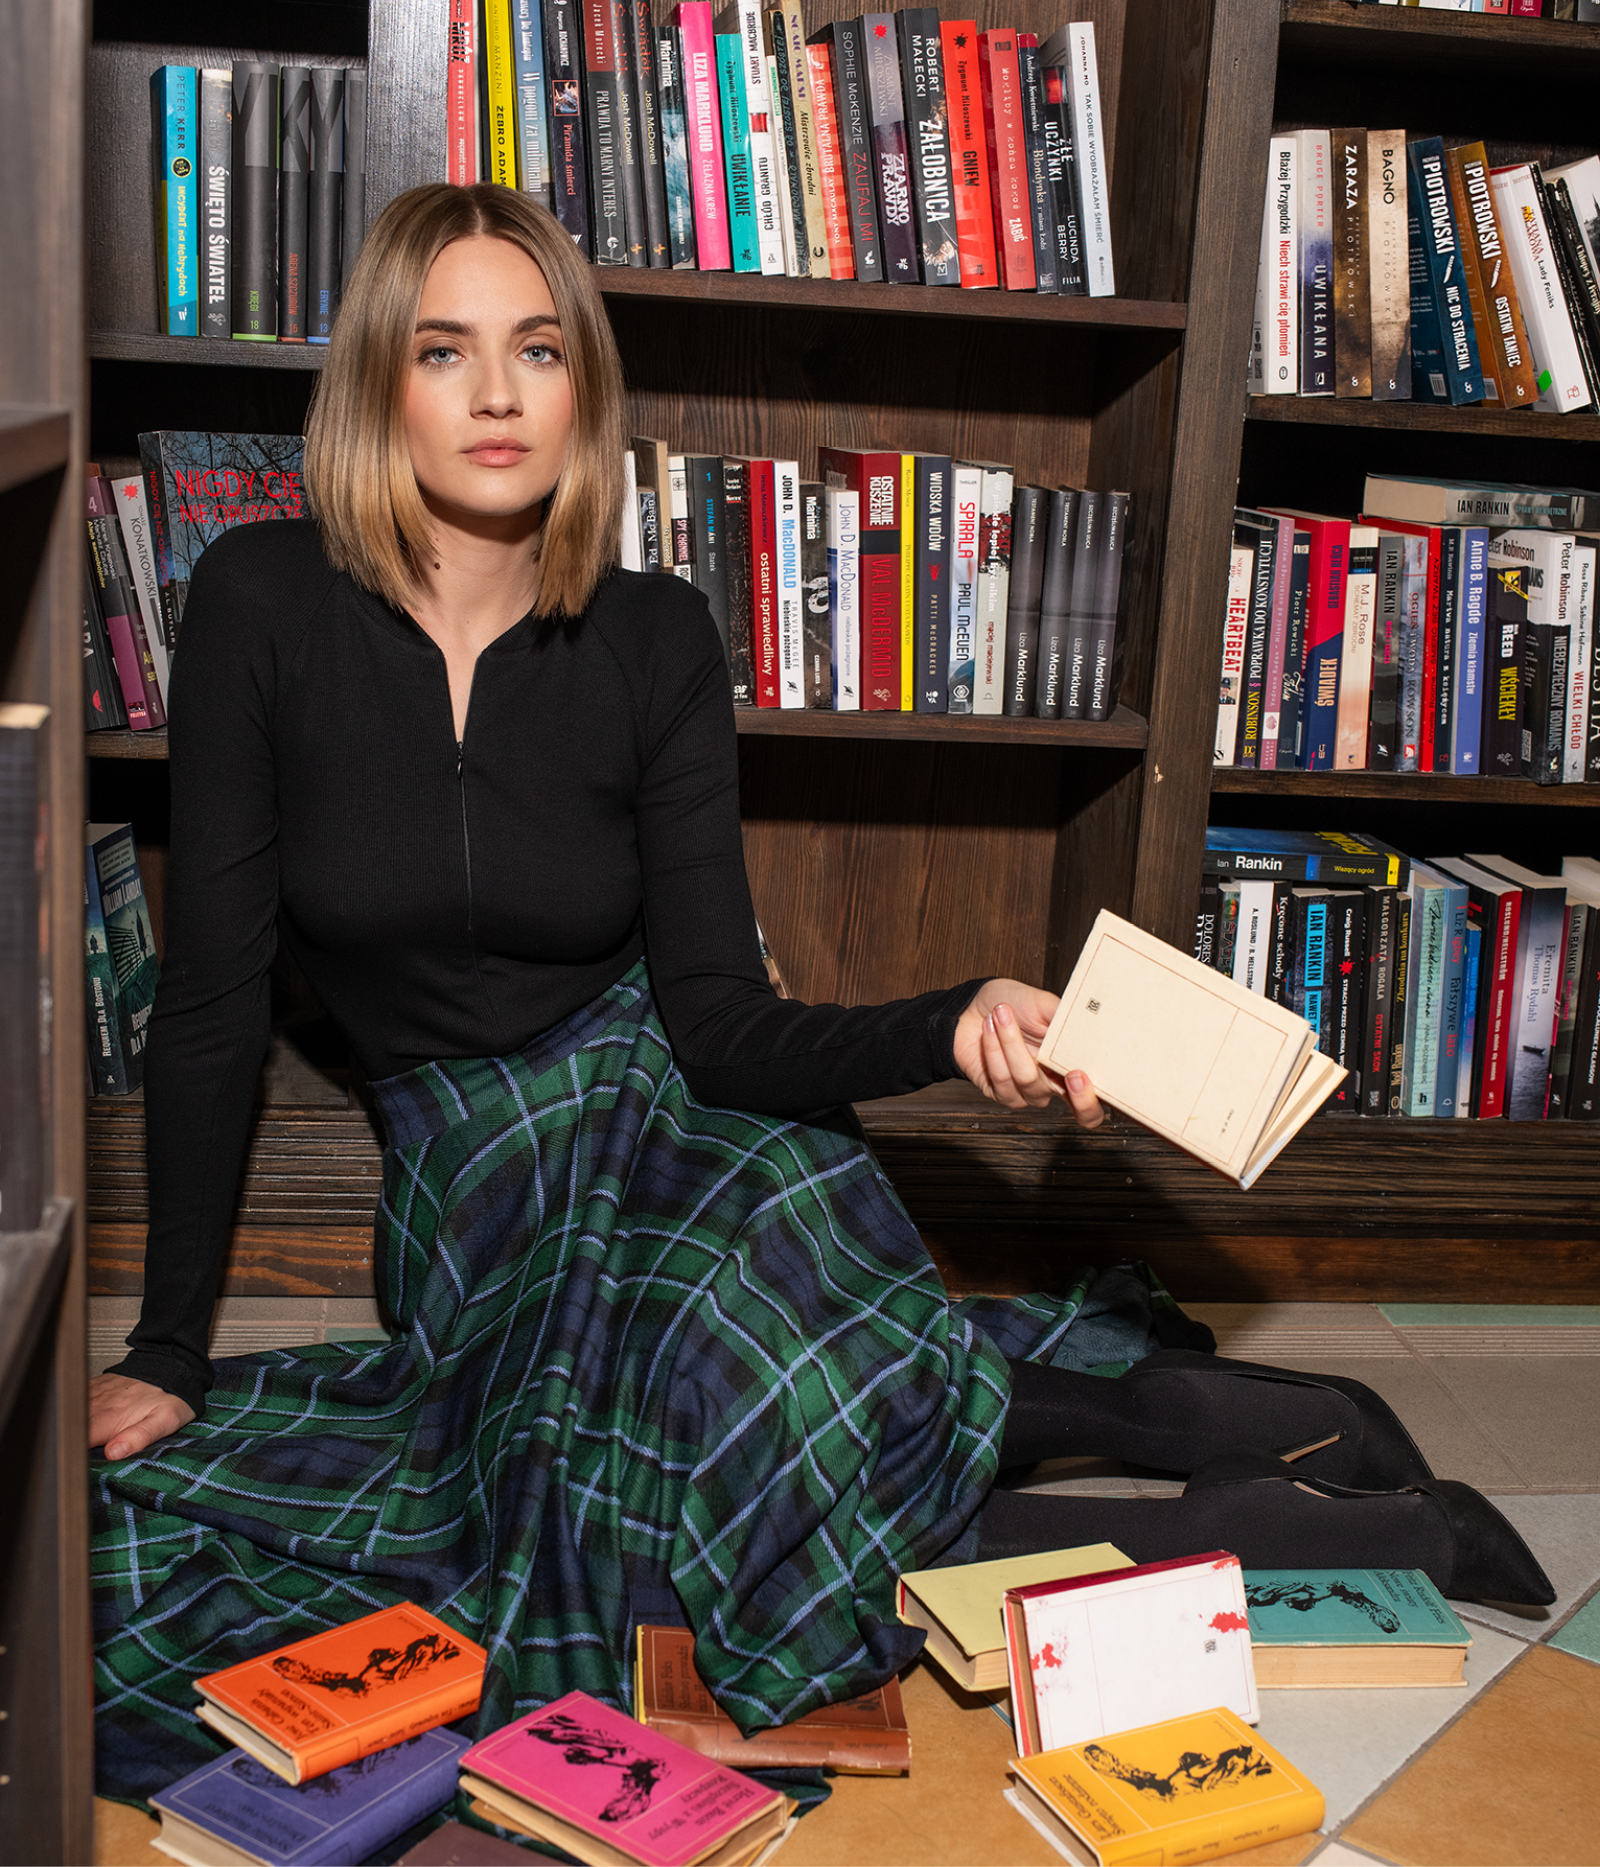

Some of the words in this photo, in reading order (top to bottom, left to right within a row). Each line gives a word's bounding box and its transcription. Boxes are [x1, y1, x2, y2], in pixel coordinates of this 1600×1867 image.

[746, 11, 758, 52] MACBRIDE
[660, 40, 674, 86] Marinina
[692, 52, 708, 79] LIZA
[750, 56, 762, 84] STUART
[842, 32, 856, 78] SOPHIE
[912, 34, 926, 98] MAŁECKI
[925, 38, 939, 92] ROBERT
[1080, 36, 1088, 72] JOHANNA
[177, 76, 186, 111] PETER
[958, 60, 970, 92] Zygmunt
[1084, 74, 1090, 86] MO
[596, 90, 611, 129] PRAWDA
[621, 91, 630, 114] Josh
[645, 90, 654, 114] Josh
[694, 81, 714, 152] MARKLUND
[814, 79, 829, 120] PRAWDA
[848, 83, 864, 145] McKENZIE
[962, 95, 972, 140] Miłoszewski
[176, 118, 186, 150] KERR
[563, 124, 574, 162] Piramida
[598, 131, 611, 144] TO
[623, 117, 634, 165] McDowell
[647, 117, 657, 165] McDowell
[1086, 112, 1094, 138] SOBIE
[600, 146, 614, 178] MARNY
[816, 124, 835, 174] BRUTALNA
[1044, 122, 1062, 181] UCZYNKI
[1060, 138, 1073, 162] ZŁE
[1278, 152, 1292, 180] Błażej
[565, 164, 576, 196] śmierci
[702, 160, 715, 195] ŻELAZNA
[759, 157, 772, 196] GRANITU
[854, 153, 871, 216] ZAUFAJ
[920, 120, 950, 222] ŻAŁOBNICA
[963, 150, 980, 186] GNIEW
[1088, 140, 1100, 210] WYOBRAŻAŁAM
[1346, 145, 1358, 210] ZARAZA
[1383, 149, 1395, 204] BAGNO
[206, 166, 230, 228] ŚWIĘTO
[603, 180, 616, 218] INTERES
[882, 152, 898, 224] PRAWDY
[896, 153, 910, 224] ZIARNO
[705, 197, 716, 220] KREW
[763, 201, 774, 230] CHŁÓD
[1278, 184, 1292, 234] Przygodzki
[1422, 163, 1456, 255] PIOTROWSKI
[1465, 167, 1502, 259] PIOTROWSKI
[862, 224, 874, 242] MI
[1057, 224, 1068, 260] BERRY
[1066, 215, 1080, 264] LUCINDA
[1094, 212, 1104, 244] ŚMIERĆ
[208, 235, 230, 304] ŚWIATEŁ
[288, 253, 298, 277] ARENA
[1280, 240, 1292, 268] Niech
[1346, 217, 1354, 318] PIOTROWSKI
[248, 290, 259, 312] KRĘGI
[288, 278, 299, 316] SZCZURÓW
[320, 290, 329, 314] ERYNIE
[1280, 270, 1292, 300] strawi
[1445, 286, 1460, 302] NIC
[250, 320, 259, 330] 18
[1278, 302, 1292, 317] cię
[1314, 264, 1327, 358] UWIKŁANA
[1449, 305, 1462, 318] DO
[1495, 296, 1514, 334] OSTATNI
[1277, 319, 1292, 356] płomień
[1451, 320, 1470, 370] STRACENIA
[1503, 336, 1521, 368] TANIEC
[150, 471, 160, 501] NIGDY
[176, 470, 256, 498] NIGDY
[264, 472, 302, 504] CIĘ
[782, 475, 794, 501] JOHN
[870, 476, 882, 526] KUSZENIE
[882, 476, 894, 526] OSTATNIE
[929, 472, 942, 514] WIOSKA
[154, 503, 163, 518] CIĘ
[180, 504, 208, 524] NIE
[782, 504, 794, 514] D.
[805, 496, 817, 540] Marinina
[1458, 500, 1474, 514] IAN
[1476, 501, 1510, 516] RANKIN
[156, 520, 164, 536] NIE
[928, 517, 946, 552] WDÓW
[958, 502, 976, 559] SPIRALA
[130, 518, 157, 597] KONATKOWSKI
[158, 538, 170, 588] OPUSZCZĘ
[782, 520, 796, 588] MacDONALD
[1470, 540, 1484, 570] Anne
[1503, 539, 1534, 562] Robinson
[1560, 542, 1572, 571] Peter
[760, 552, 772, 594] ostatni
[872, 558, 892, 588] VAL
[1255, 540, 1272, 608] KONSTYTUCJI
[1328, 570, 1342, 609] SEBASTIAN
[1470, 574, 1484, 584] B.
[930, 594, 938, 618] PATTI
[958, 584, 972, 612] PAUL
[1468, 587, 1482, 624] Ragde
[1558, 574, 1570, 620] Robinson
[872, 592, 892, 677] McDERMID
[1224, 598, 1246, 672] HEARTBEAT
[1254, 610, 1266, 623] DO
[757, 598, 774, 676] sprawiedliwy
[929, 624, 938, 675] McCRACKEN
[956, 615, 970, 660] McEUEN
[1019, 632, 1027, 648] Liza
[1050, 636, 1059, 652] Liza
[1074, 638, 1082, 653] Liza
[1097, 640, 1106, 655] Liza
[1250, 626, 1266, 678] POPRAWKA
[1467, 632, 1478, 660] Ziemia
[1501, 624, 1514, 658] REED
[1015, 648, 1028, 701] Marklund
[1046, 652, 1059, 706] Marklund
[1070, 654, 1083, 707] Marklund
[1092, 656, 1106, 709] Marklund
[1314, 658, 1338, 706] ŚWIADEK
[1466, 660, 1477, 694] kłamstw
[1550, 636, 1567, 708] NIEBEZPIECZNY
[1498, 666, 1520, 720] WŚCIEKŁY
[1245, 691, 1260, 740] ROBINSON
[1548, 710, 1562, 751] ROMANS
[1216, 859, 1230, 868] Ian
[1235, 856, 1282, 870] Rankin
[1334, 866, 1357, 874] Wiszący
[1358, 866, 1374, 874] ogród
[1310, 910, 1324, 931] IAN
[1378, 896, 1390, 962] MAŁGORZATA
[1454, 912, 1464, 926] Liz
[1571, 916, 1582, 932] IAN
[1202, 914, 1215, 962] DOLORES
[1450, 928, 1463, 964] Rigbey
[1566, 934, 1580, 974] RANKIN
[1308, 936, 1322, 982] RANKIN
[1530, 944, 1544, 986] Thomas
[1542, 944, 1556, 994] Eremita
[92, 977, 106, 1008] BOSTONU
[1376, 967, 1387, 1000] ROGALA
[97, 1009, 108, 1024] DLA
[1308, 994, 1319, 1019] NAWET
[1444, 977, 1461, 1031] Fałszywe
[1525, 988, 1540, 1022] Rydahl
[99, 1026, 112, 1057] REQUIEM
[1374, 1014, 1384, 1048] OSTATNI
[1446, 1034, 1458, 1057] lato
[1372, 1051, 1382, 1074] SKOK
